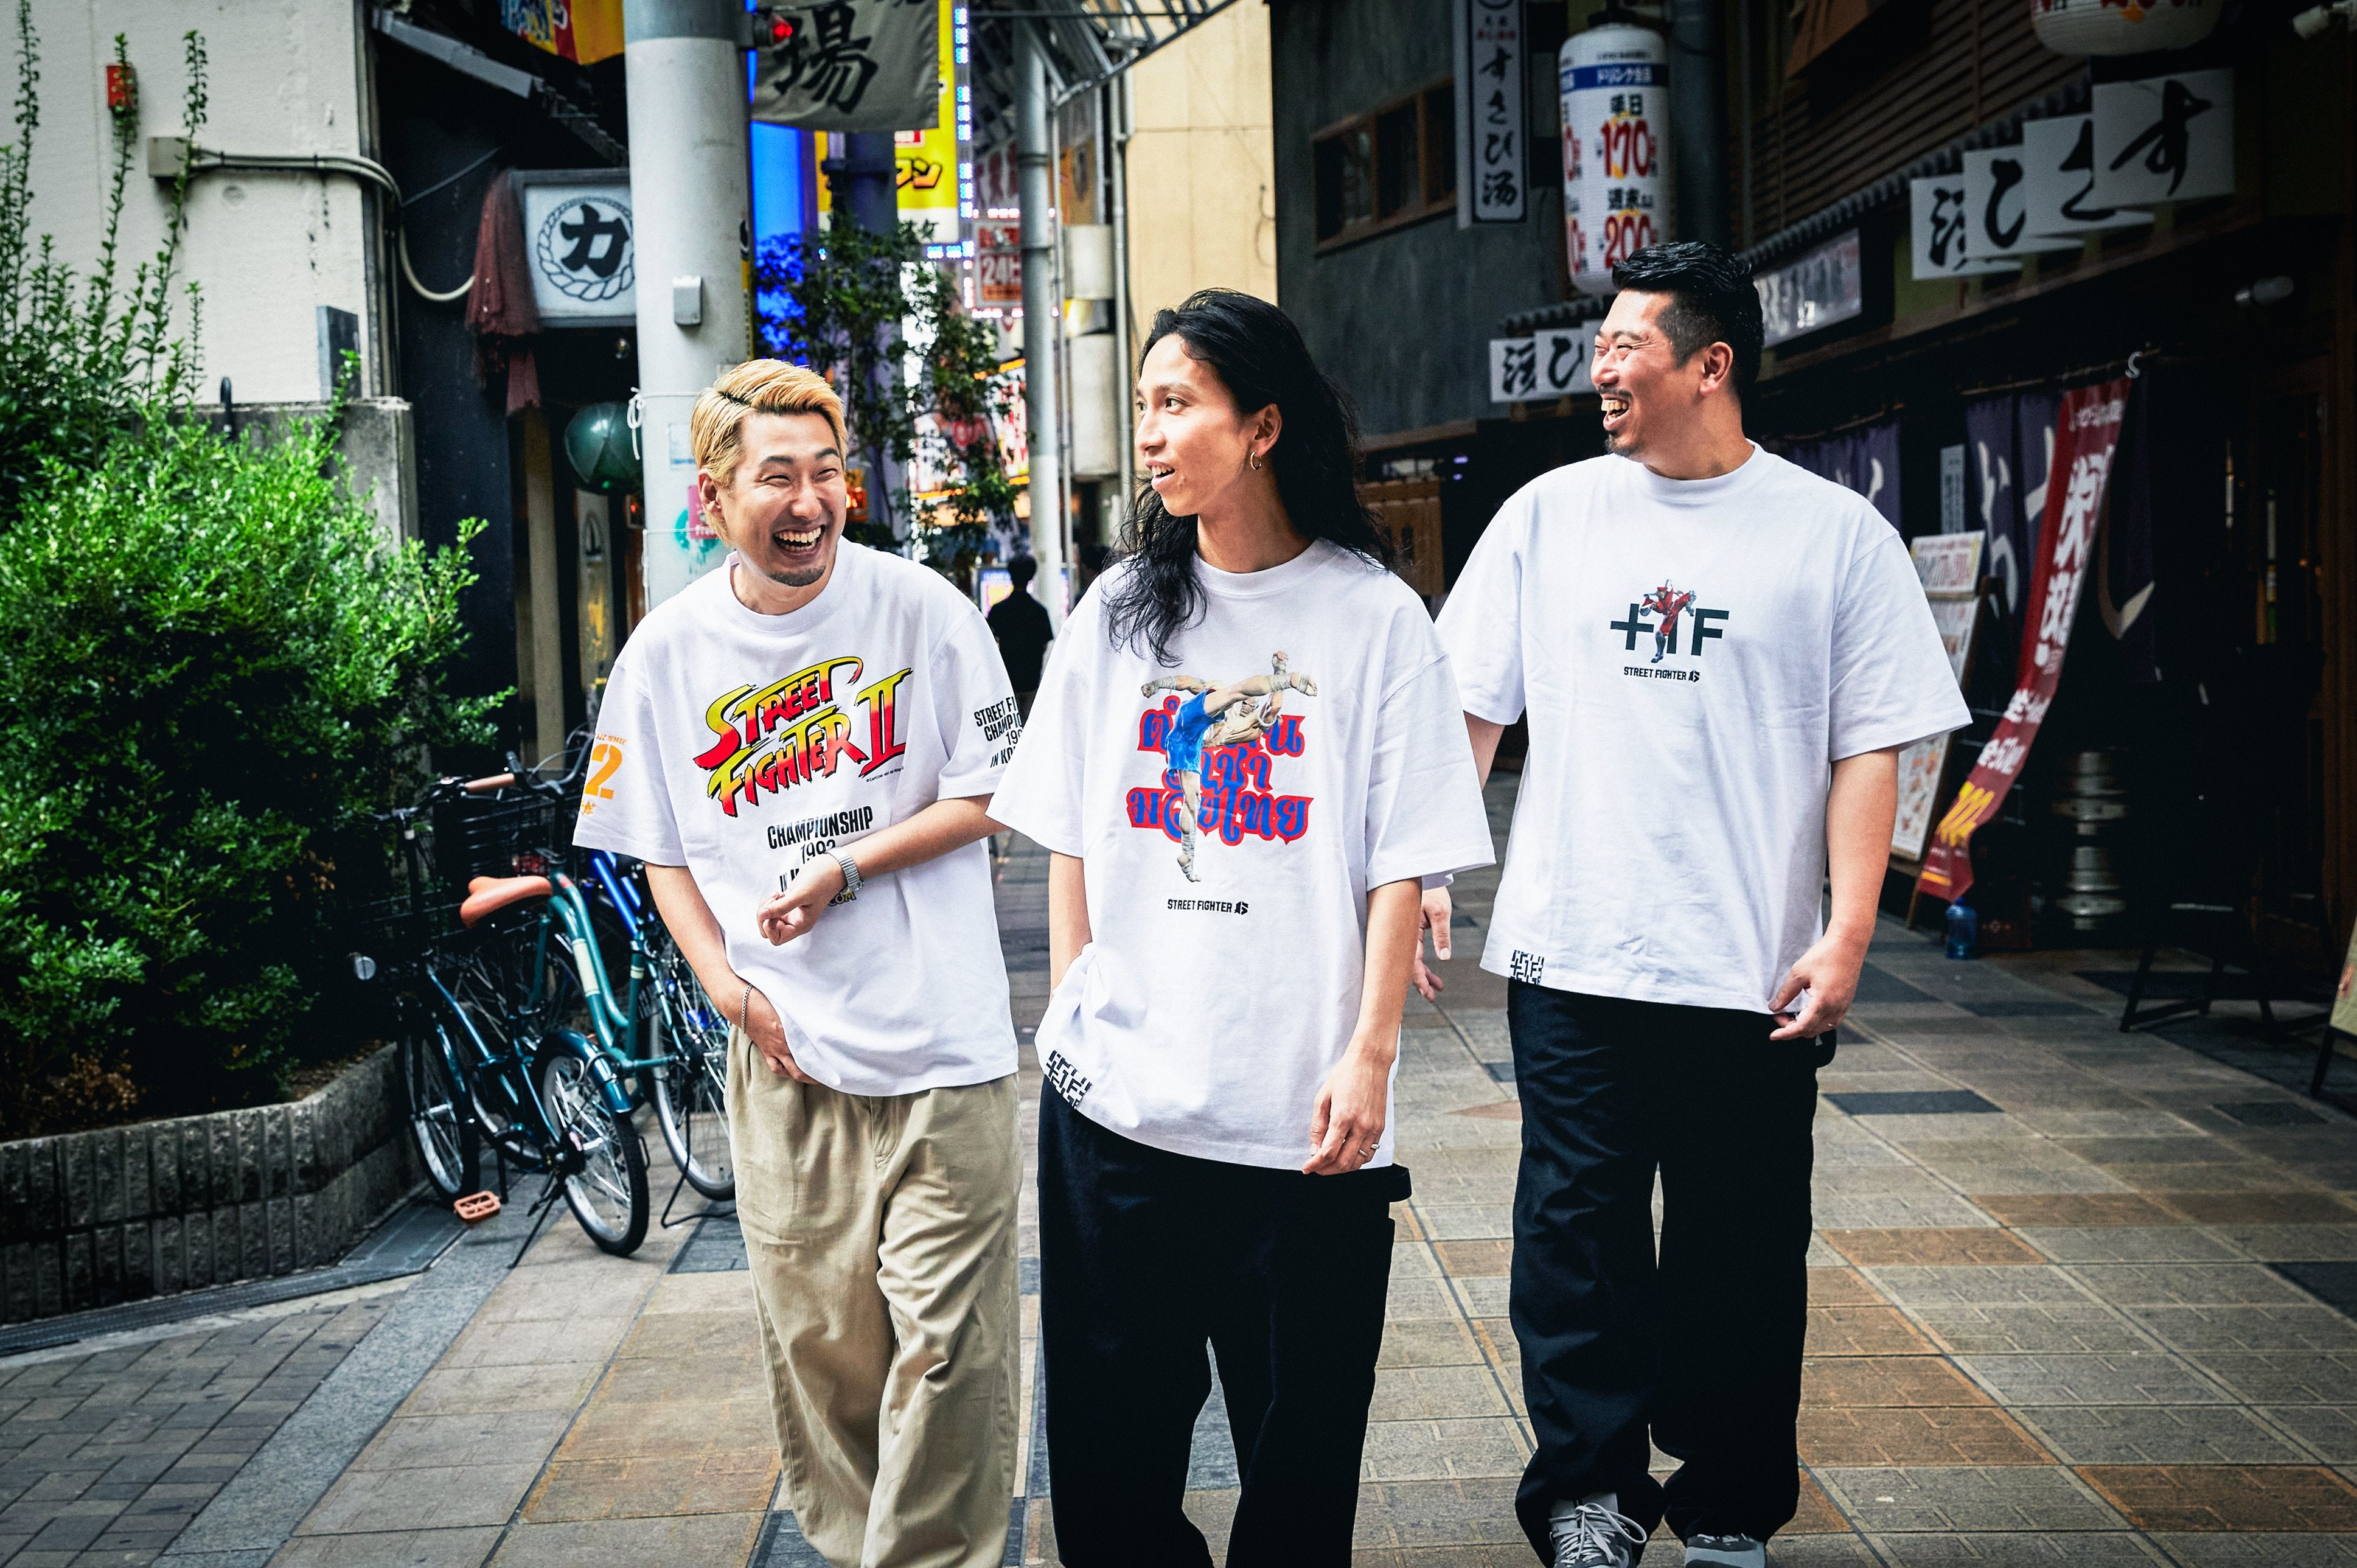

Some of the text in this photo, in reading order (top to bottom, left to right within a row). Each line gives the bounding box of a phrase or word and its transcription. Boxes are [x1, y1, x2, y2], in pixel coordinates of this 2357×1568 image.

[1601, 120, 1648, 178] 170
[1624, 666, 1654, 678] STREET
[1655, 669, 1687, 681] FIGHTER
[694, 657, 863, 771] STREET
[973, 700, 1006, 727] STREET
[607, 734, 627, 745] SHIP
[990, 746, 1016, 768] IN KO
[585, 744, 623, 800] 2
[707, 705, 870, 818] FIGHTER
[767, 806, 873, 849] CHAMPIONSHIP
[1167, 898, 1196, 910] STREET
[1197, 900, 1233, 913] FIGHTER
